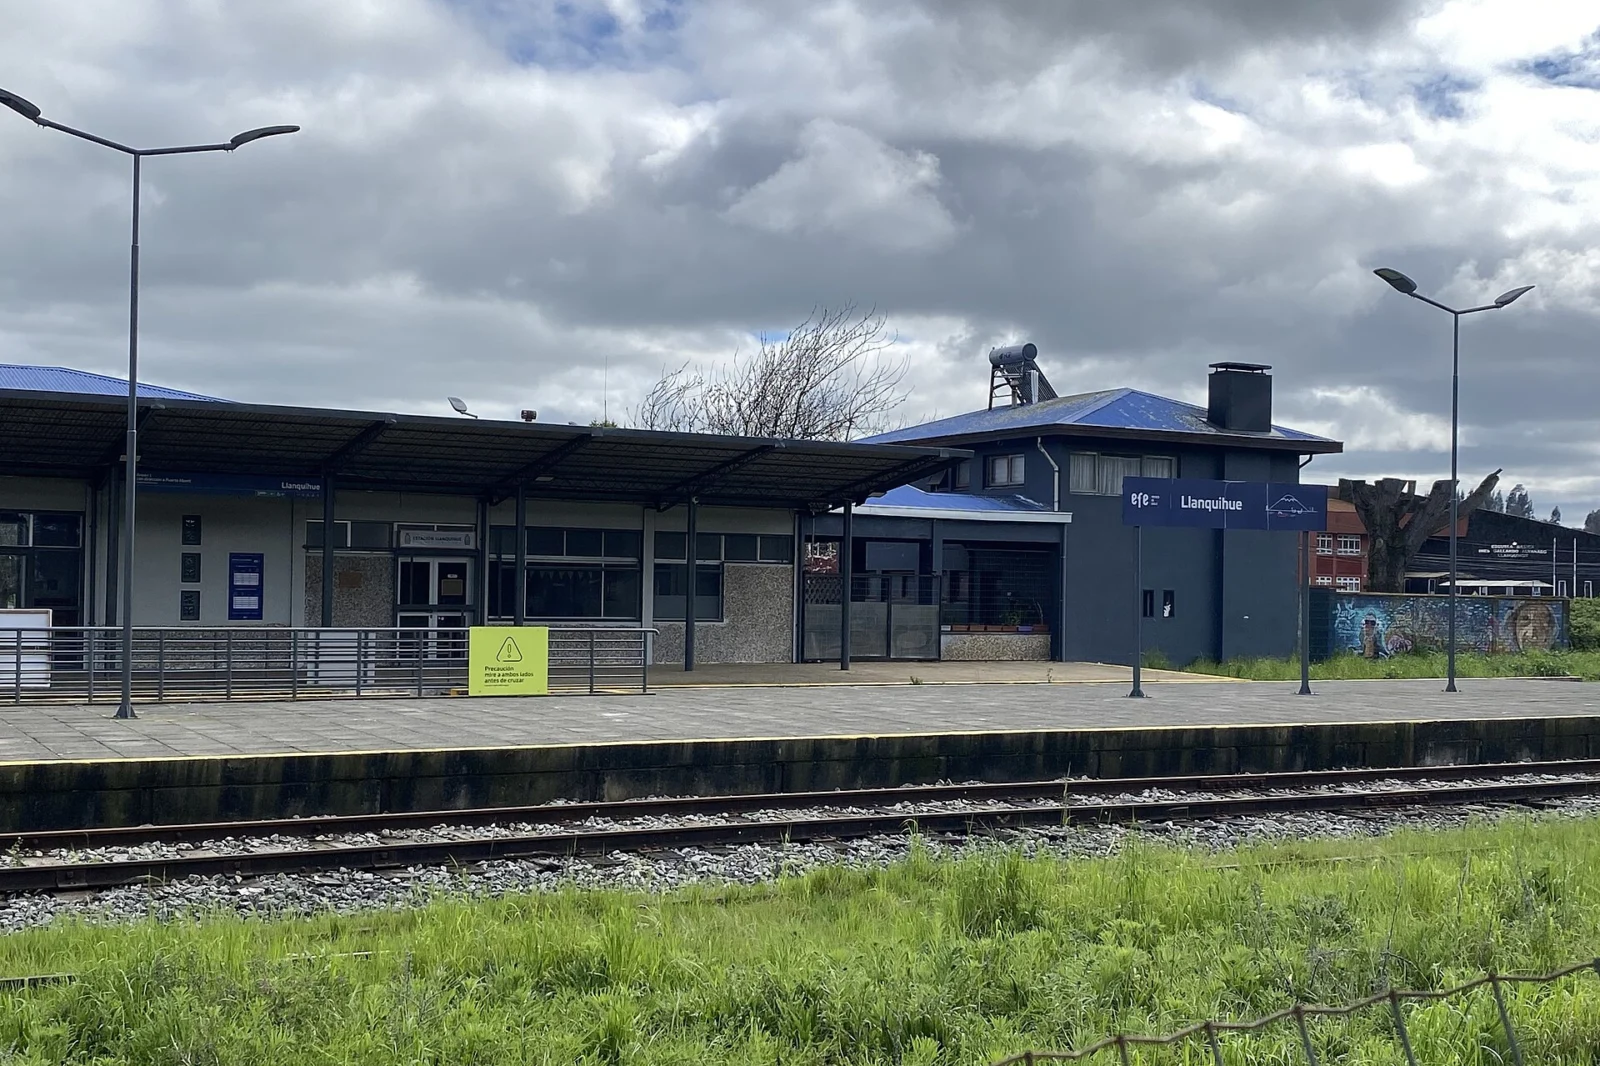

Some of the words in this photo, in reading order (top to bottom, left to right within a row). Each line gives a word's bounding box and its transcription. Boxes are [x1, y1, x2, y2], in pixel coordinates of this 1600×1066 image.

[281, 481, 321, 491] Llanquihue
[1131, 492, 1149, 509] efe
[1181, 494, 1243, 513] Llanquihue
